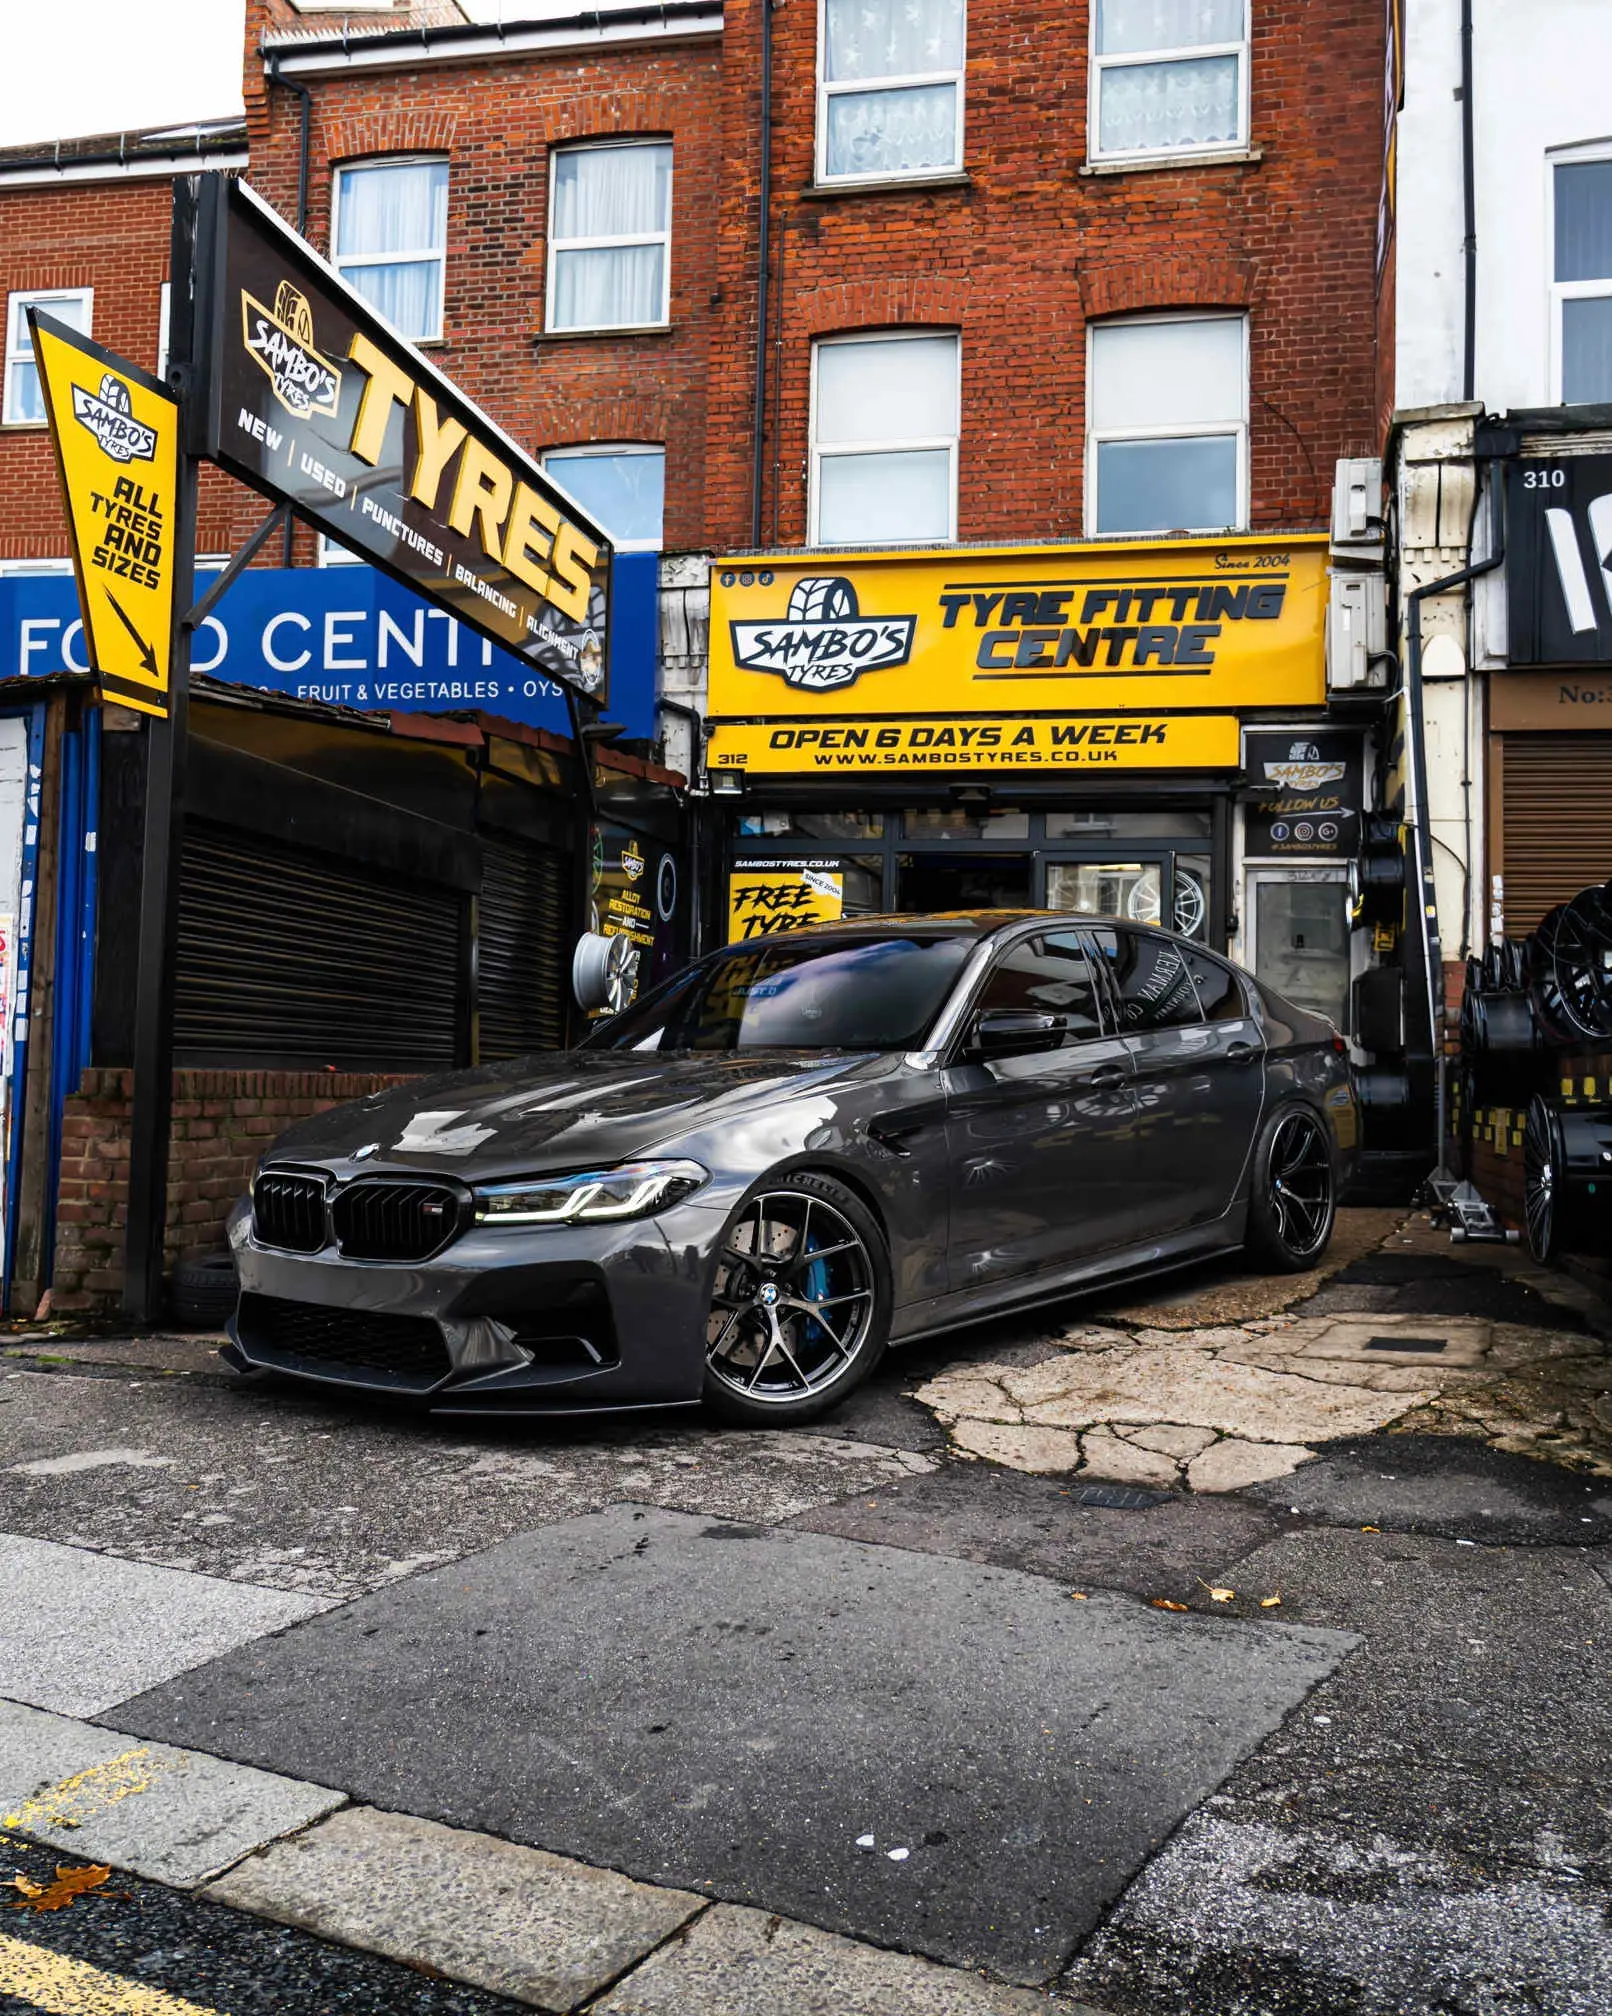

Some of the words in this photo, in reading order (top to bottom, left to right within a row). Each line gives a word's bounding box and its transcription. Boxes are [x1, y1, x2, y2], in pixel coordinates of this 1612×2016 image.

[247, 319, 336, 403] SAMBO'S
[273, 371, 311, 411] TYRES
[77, 399, 152, 452] SAMBO'S
[97, 433, 131, 458] TYRES
[112, 475, 163, 520] ALL
[349, 332, 598, 624] TYRES
[1523, 469, 1565, 489] 310
[90, 491, 163, 541] TYRES
[238, 407, 283, 451] NEW
[301, 452, 346, 499] USED
[362, 496, 444, 567] PUNCTURES
[455, 563, 518, 619] BALANCING
[526, 615, 579, 662] ALIGNMENT
[103, 523, 162, 568] AND
[1214, 553, 1250, 570] Since
[1253, 552, 1291, 568] 2004
[91, 545, 161, 591] SIZES
[939, 590, 1075, 628] TYRE
[1079, 584, 1287, 624] FITTING
[20, 615, 229, 676] FD
[741, 625, 907, 664] SAMBO'S
[976, 624, 1222, 669] CENTRE
[297, 684, 352, 701] FRUIT
[357, 683, 368, 700] &
[374, 681, 499, 700] VEGETABLES
[523, 680, 565, 697] OYS
[788, 662, 853, 682] TYRES
[769, 728, 863, 749] OPEN
[875, 728, 902, 748] 6
[908, 726, 1002, 748] DAYS
[1011, 726, 1035, 746] A
[1051, 724, 1168, 745] WEEK
[718, 754, 748, 765] 312
[814, 750, 1118, 765] WWW.SAMBOSTYRES.CO.UK
[734, 860, 840, 868] SAMBOSTYRES.CO.UK
[804, 872, 824, 887] SINCE
[734, 882, 816, 913] FREE
[622, 915, 637, 929] AND
